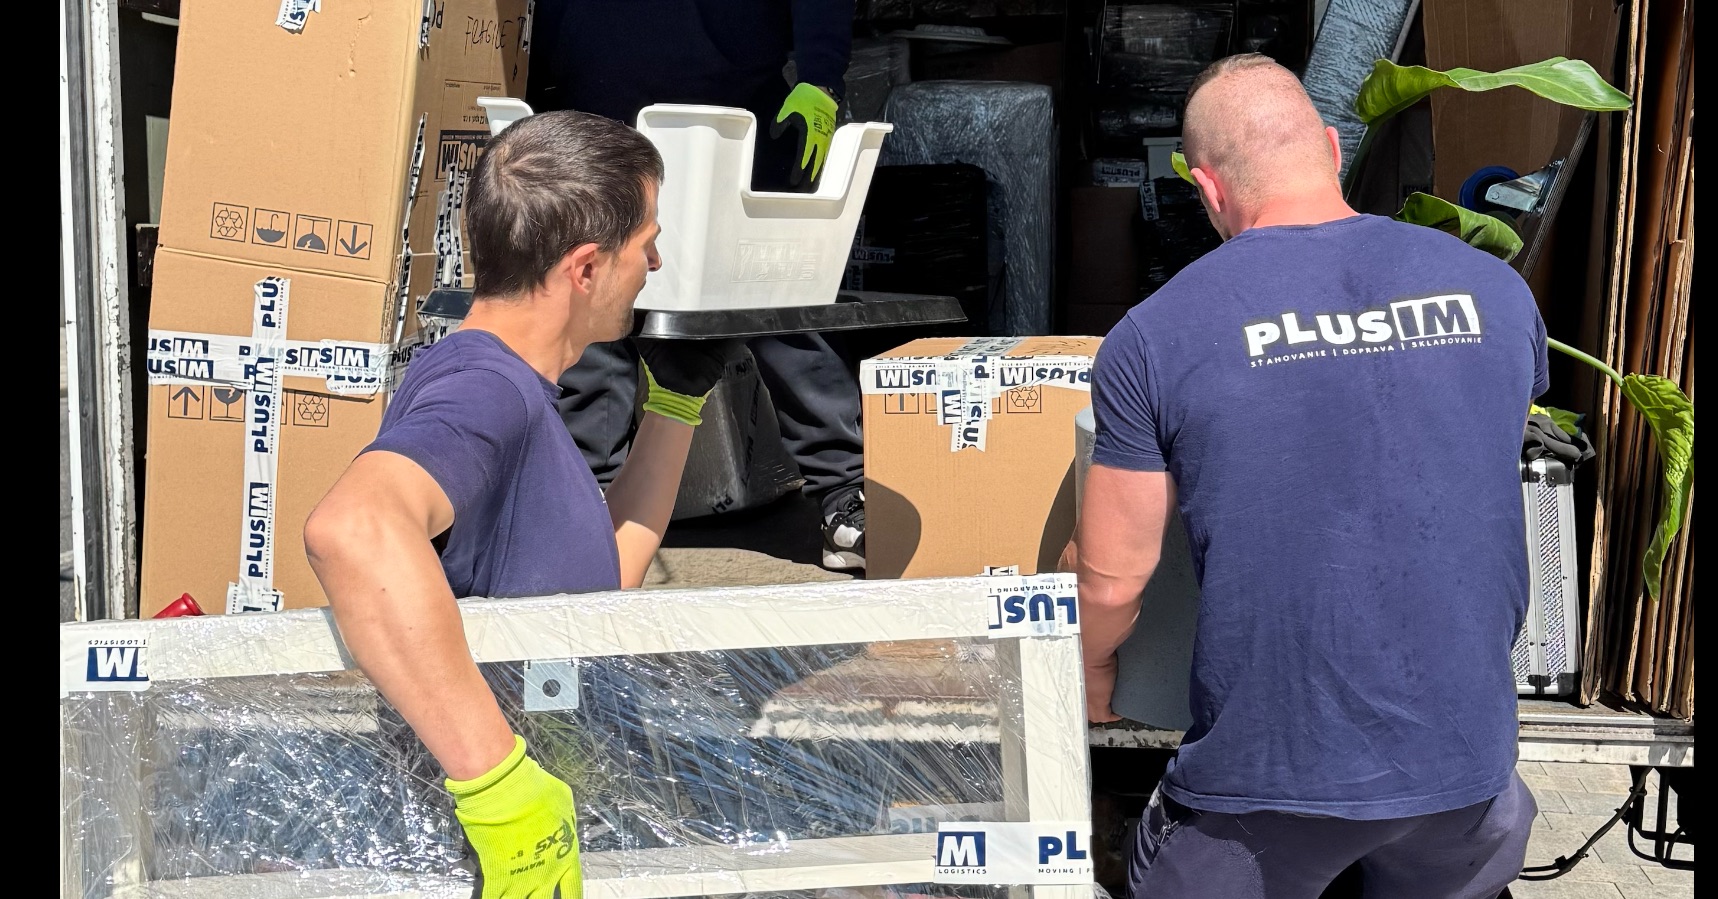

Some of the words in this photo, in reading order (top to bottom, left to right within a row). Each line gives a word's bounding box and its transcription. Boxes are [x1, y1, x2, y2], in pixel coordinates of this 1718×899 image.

[1244, 295, 1481, 356] PLUSIM
[1343, 345, 1395, 356] DOPRAVA
[1411, 337, 1482, 348] SKLADOVANIE
[252, 357, 275, 453] PLUSIM
[246, 482, 269, 578] PLUSIM
